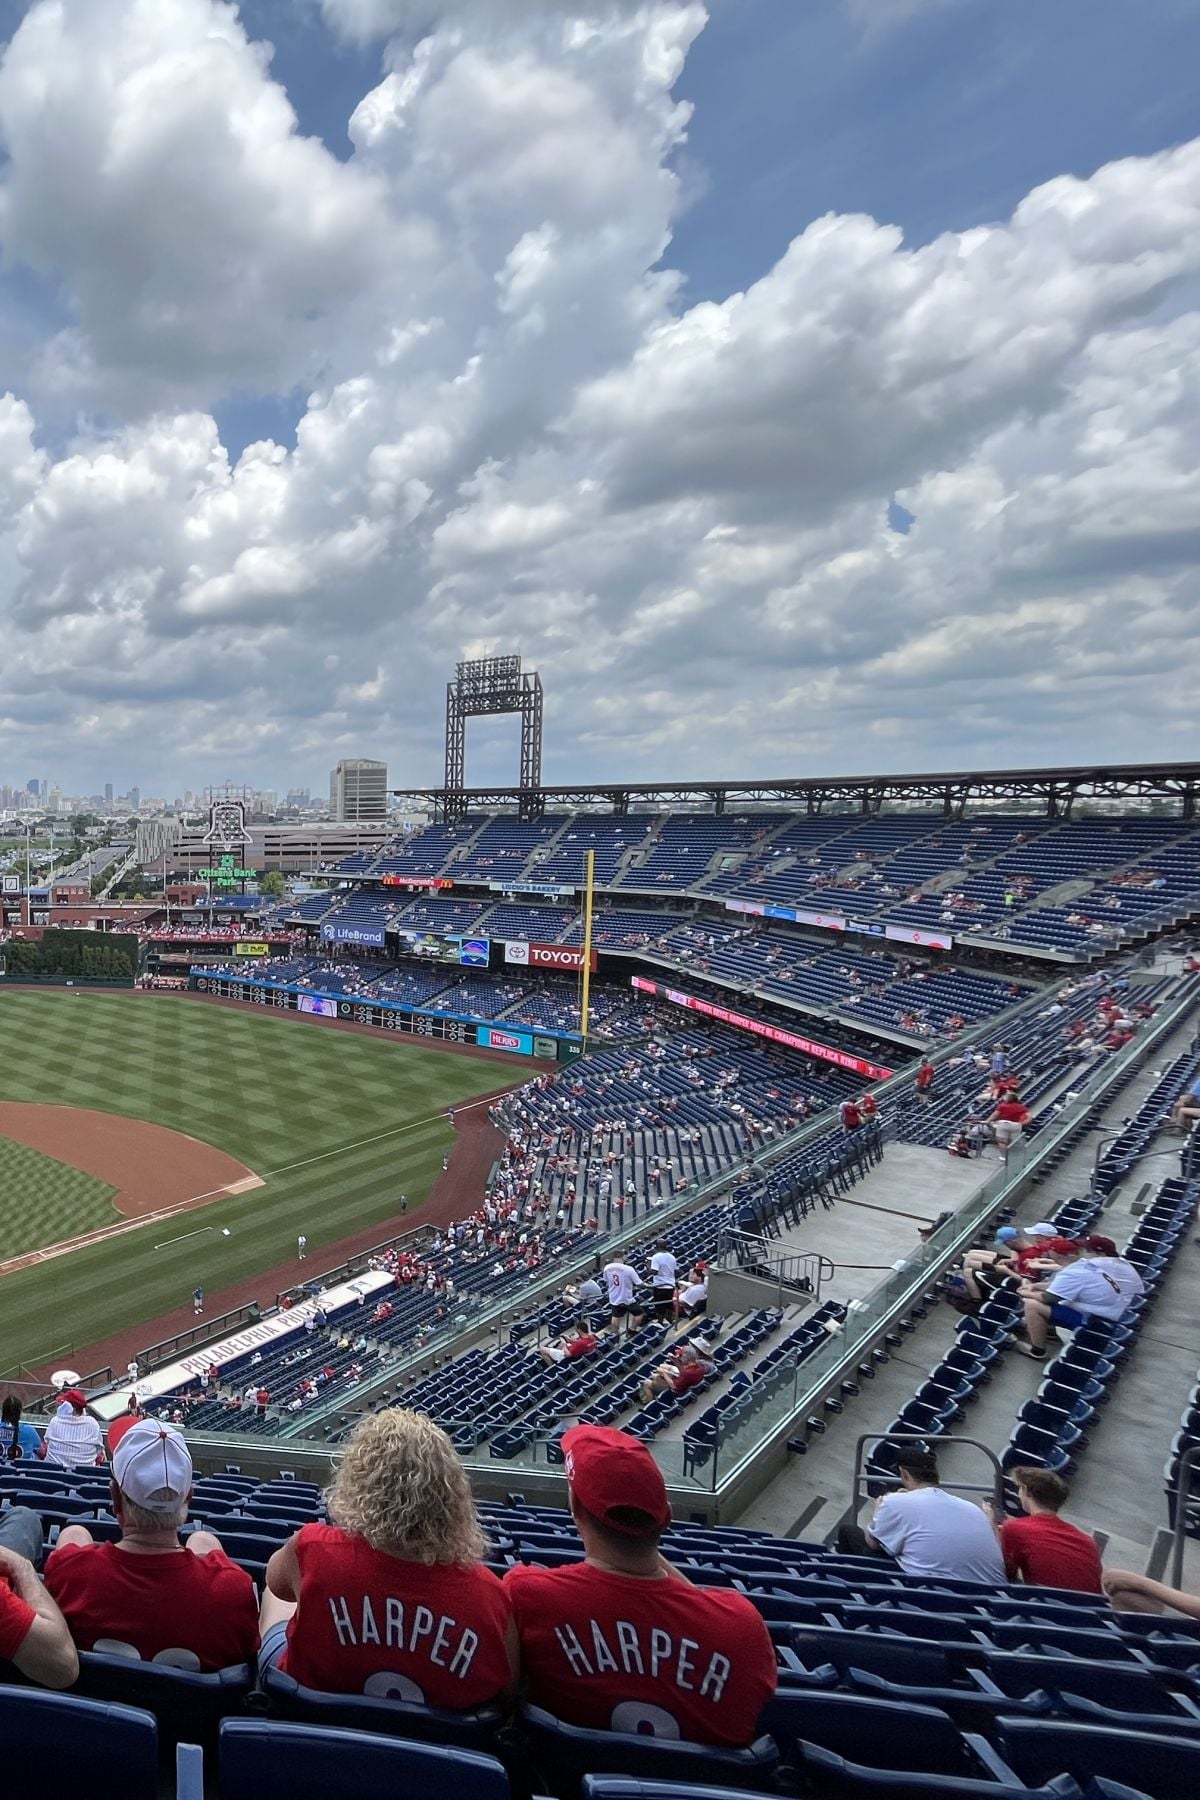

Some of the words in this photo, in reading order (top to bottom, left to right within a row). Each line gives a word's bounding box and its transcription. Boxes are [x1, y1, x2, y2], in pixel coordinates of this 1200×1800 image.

[198, 868, 232, 877] Citizens
[234, 868, 256, 877] Bank
[217, 878, 237, 886] Park
[532, 884, 560, 892] BAKERY
[337, 929, 382, 942] LifeBrand
[612, 1274, 620, 1287] 3
[179, 1324, 280, 1375] PHILADELPHIA
[329, 1594, 481, 1679] HARPER
[554, 1619, 731, 1703] HARPER
